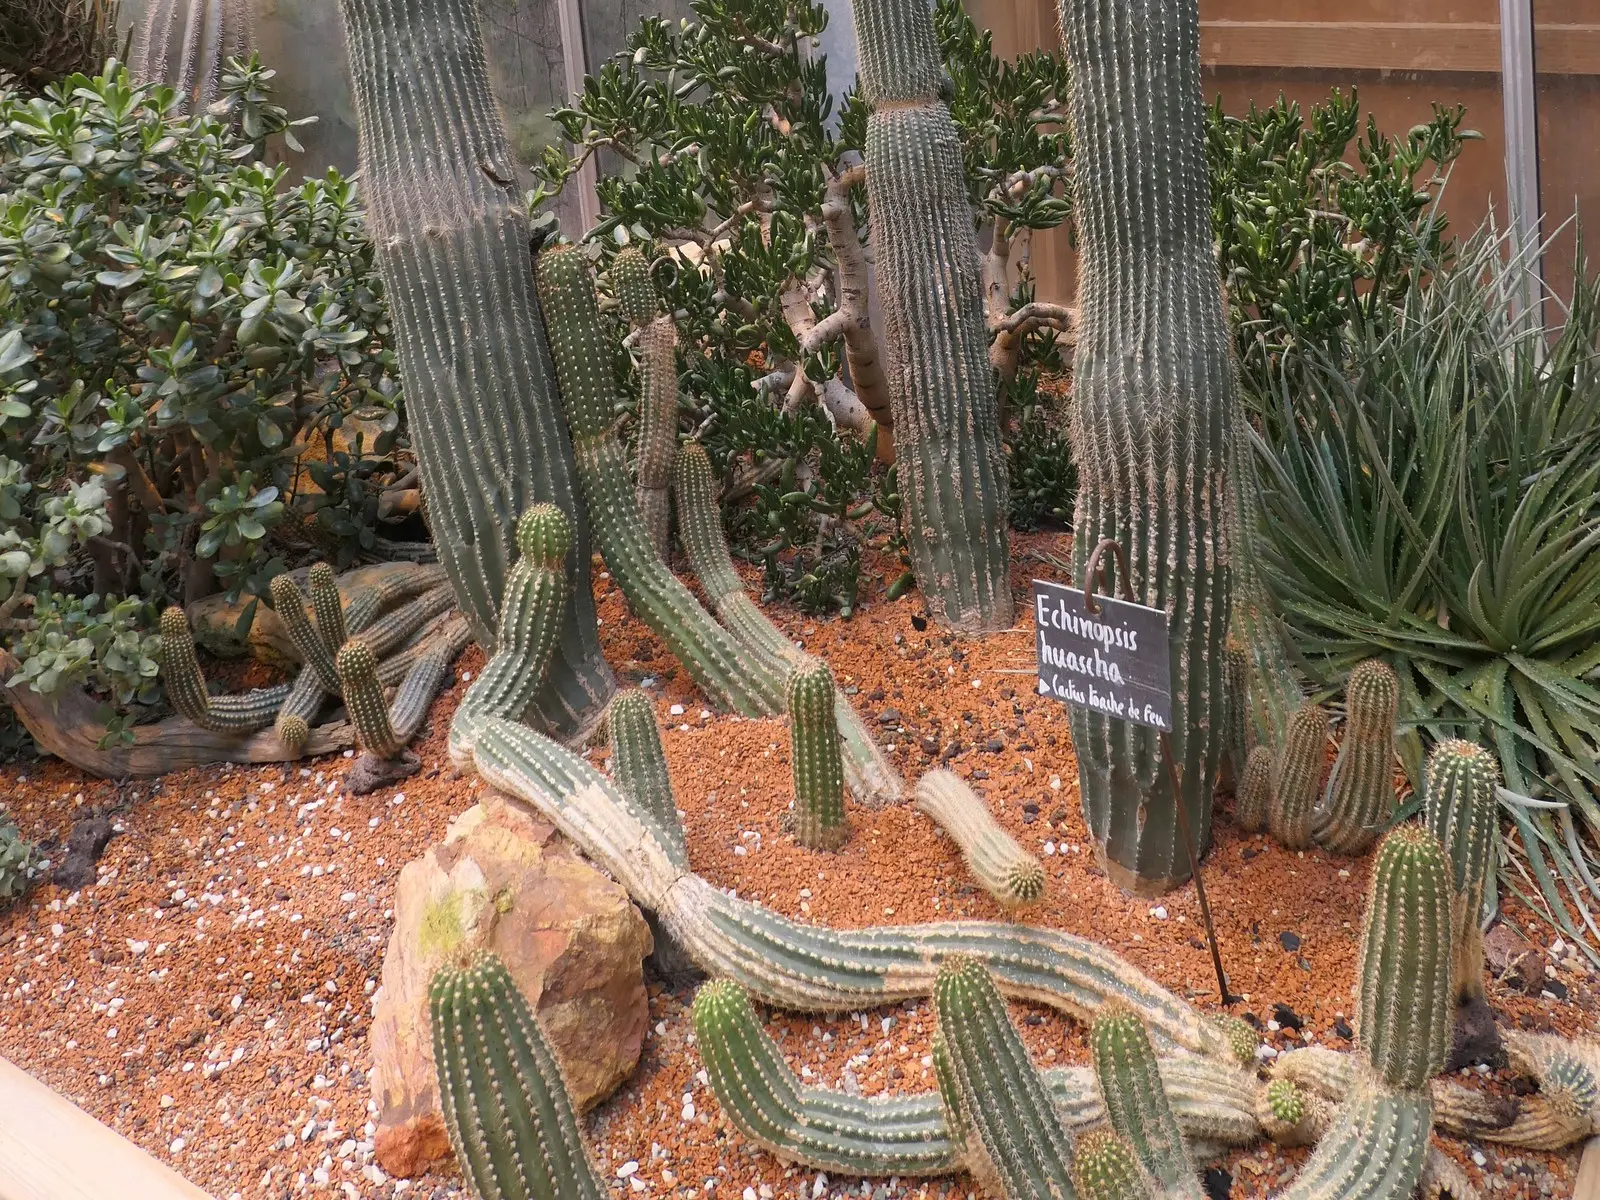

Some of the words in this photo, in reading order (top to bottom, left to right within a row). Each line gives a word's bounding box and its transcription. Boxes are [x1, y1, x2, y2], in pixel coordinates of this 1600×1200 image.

[1037, 594, 1138, 653] Echinopsis
[1040, 630, 1125, 686] huascha
[1052, 674, 1086, 704] Cactus
[1089, 684, 1124, 716] torche
[1128, 698, 1140, 721] de
